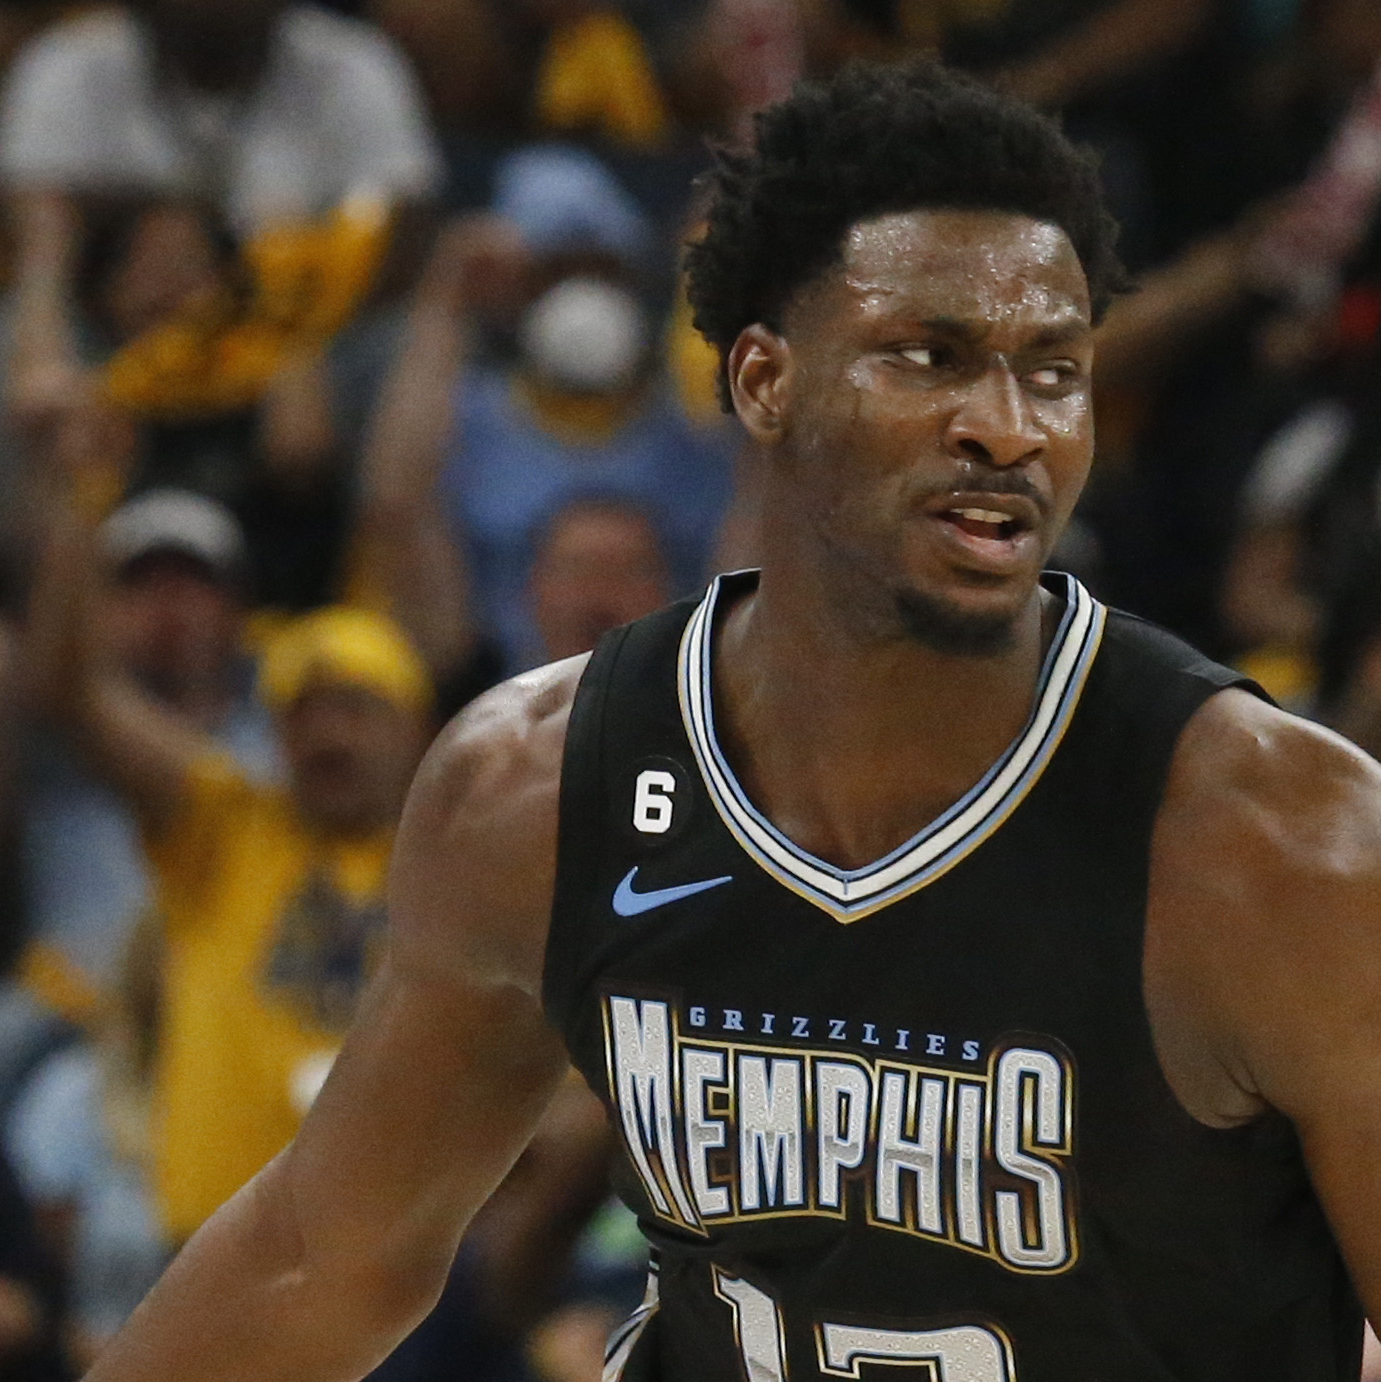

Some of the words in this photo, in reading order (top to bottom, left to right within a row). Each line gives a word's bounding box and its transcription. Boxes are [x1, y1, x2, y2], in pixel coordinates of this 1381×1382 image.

[632, 769, 677, 834] 6
[688, 1006, 980, 1061] GRIZZLIES
[604, 995, 1079, 1274] MEMPHIS
